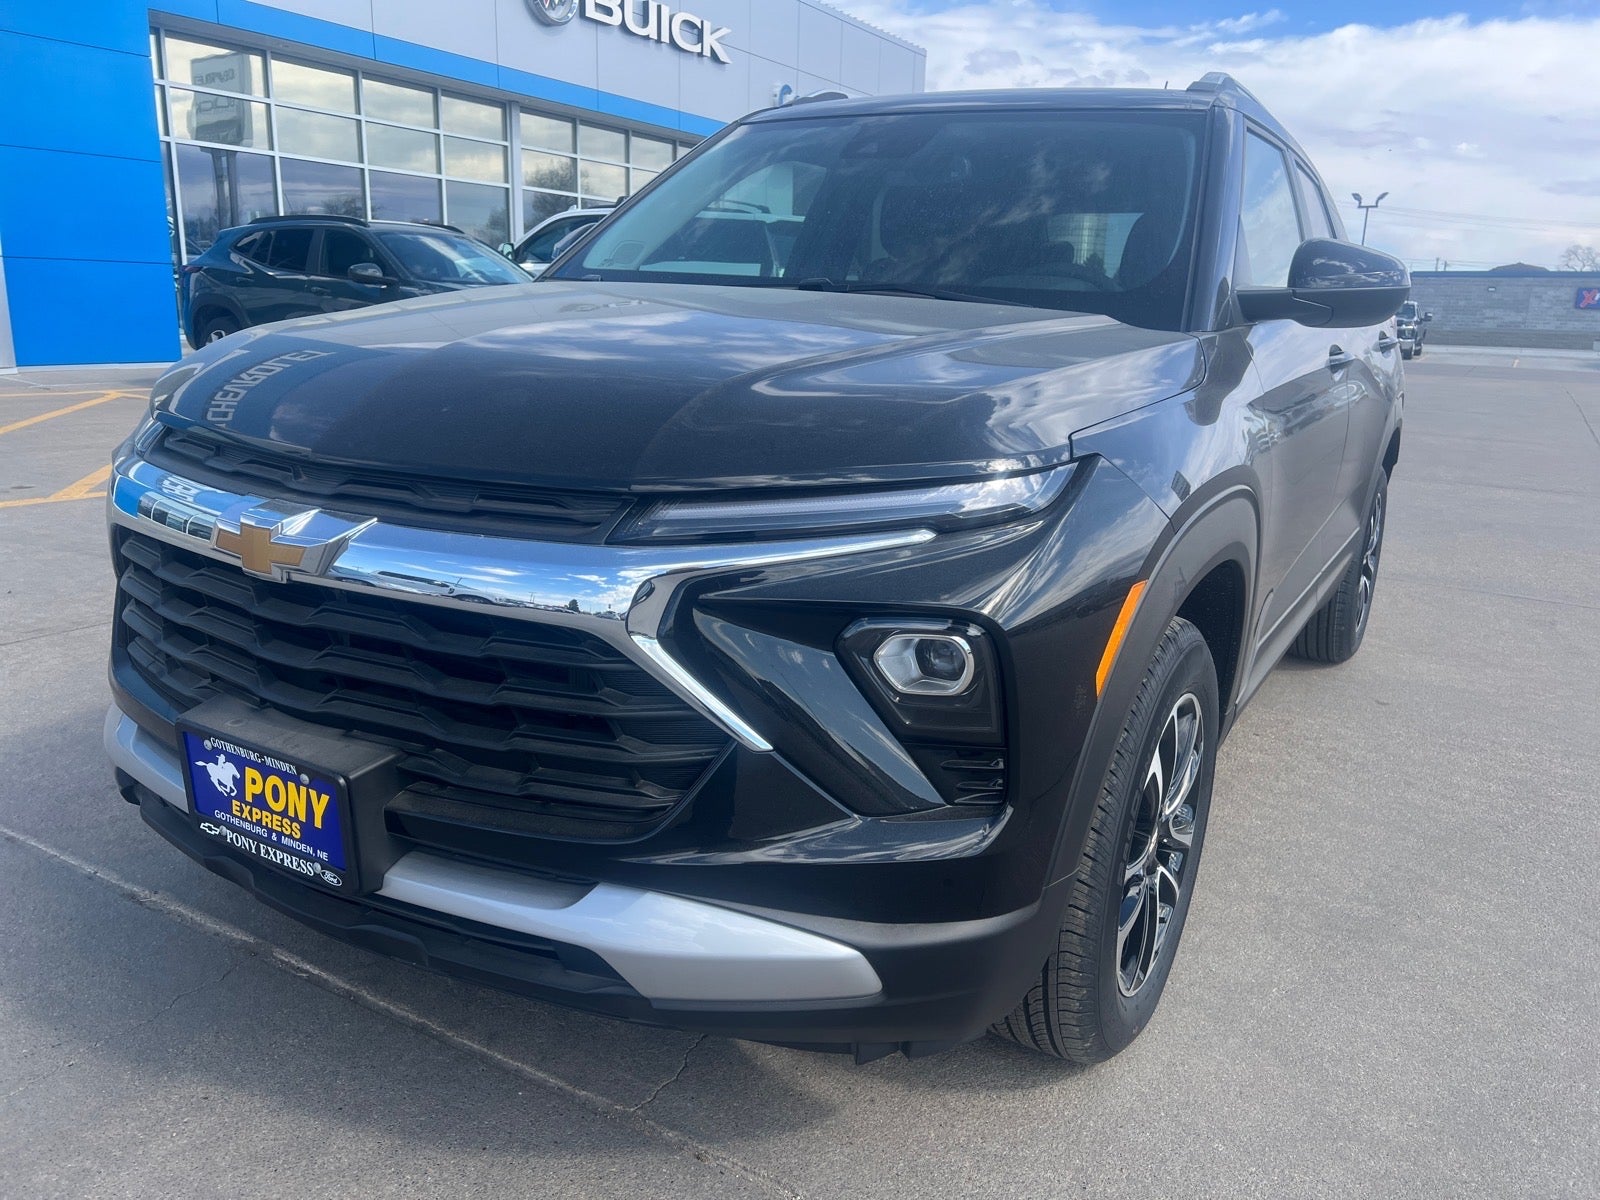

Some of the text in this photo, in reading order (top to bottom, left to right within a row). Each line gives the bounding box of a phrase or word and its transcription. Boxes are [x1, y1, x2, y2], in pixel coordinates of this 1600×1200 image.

[231, 799, 301, 839] EXPRESS
[244, 766, 330, 829] PONY
[214, 809, 329, 861] GOTHENBURG & MINDEN, NE
[225, 829, 258, 855] PONY
[258, 843, 315, 877] EXPRESS
